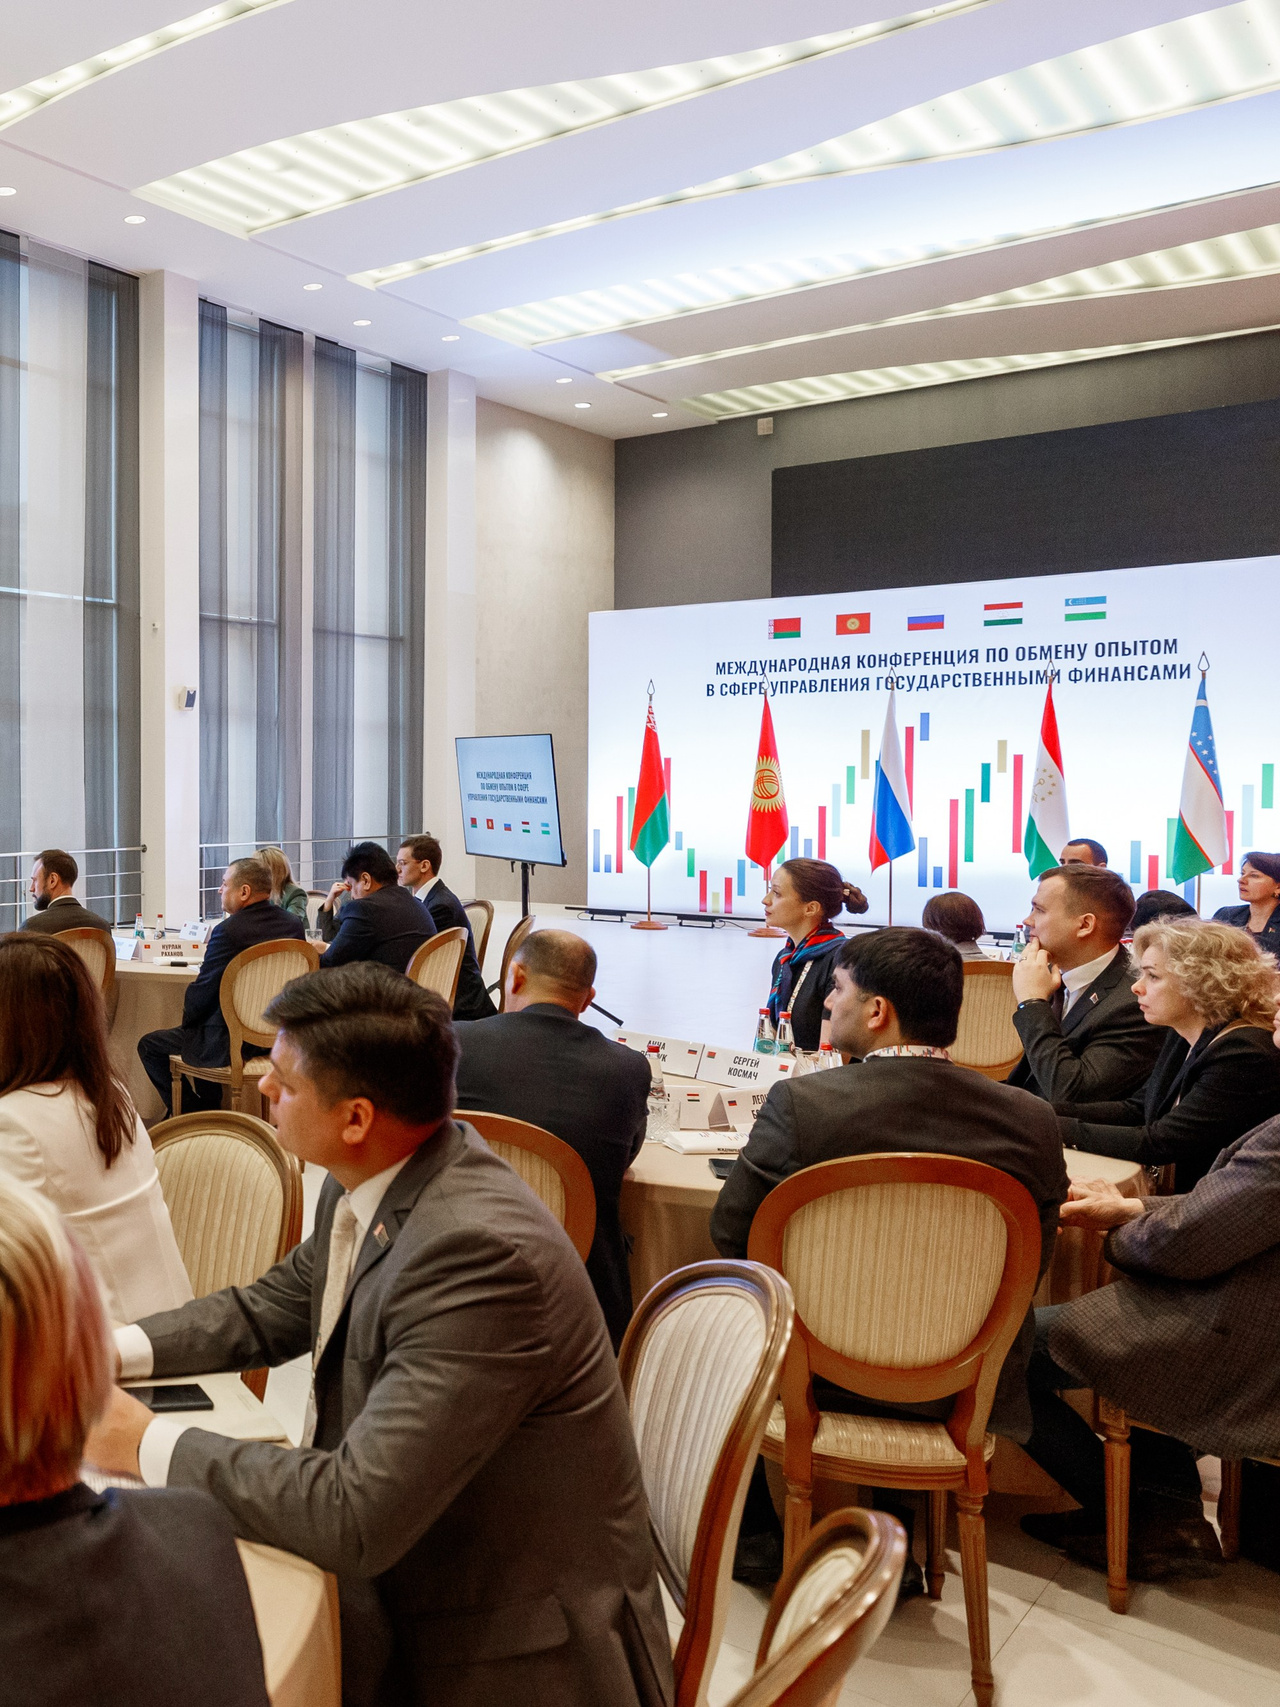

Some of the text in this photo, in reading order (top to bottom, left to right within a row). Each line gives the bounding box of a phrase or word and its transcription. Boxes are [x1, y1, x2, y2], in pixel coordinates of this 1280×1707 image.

[715, 638, 1178, 677] МЕЖДУНАРОДНАЯ КОНФЕРЕНЦИЯ ПО ОБМЕНУ ОПЫТОМ
[706, 663, 1191, 697] В СФЕРЕ УПРАВЛЕНИЯ ГОСУДАРСТВЕННЫМИ ФИНАНСАМИ
[727, 1066, 759, 1081] КОСМАЧ
[733, 1055, 760, 1069] СЕРГЕЙ
